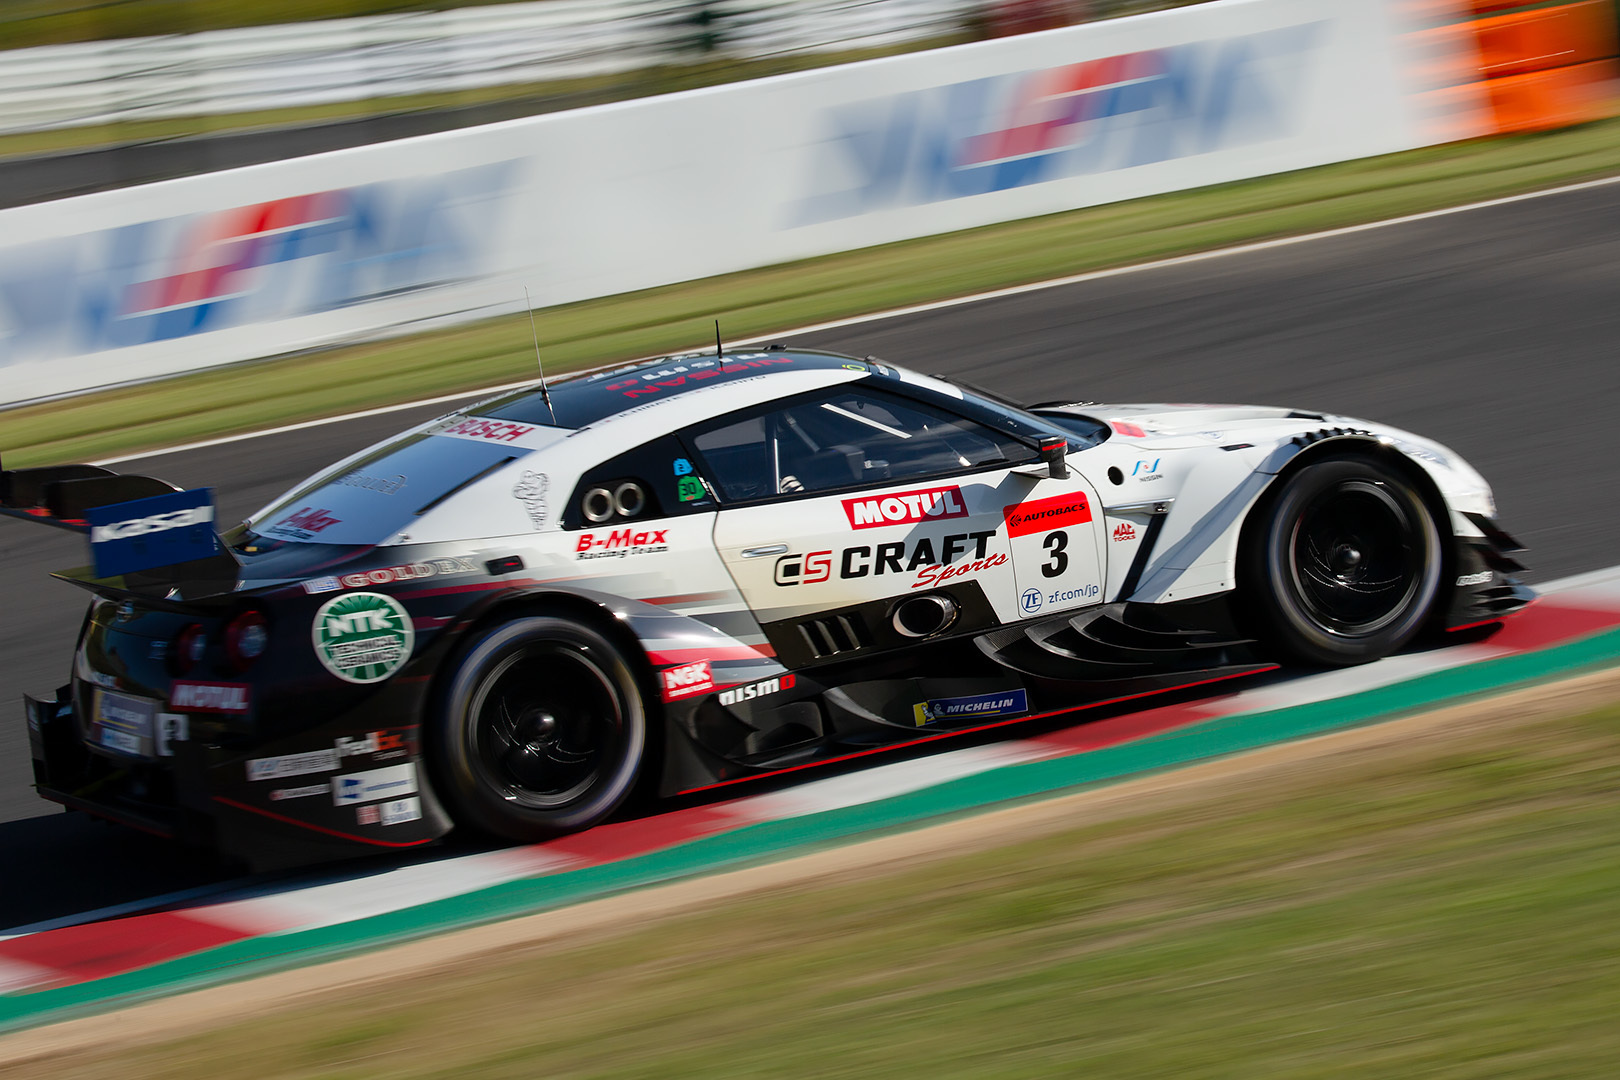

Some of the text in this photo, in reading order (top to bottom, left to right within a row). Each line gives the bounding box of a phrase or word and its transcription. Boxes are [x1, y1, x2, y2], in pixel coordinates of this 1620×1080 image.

[622, 357, 794, 399] NISSAN
[444, 419, 536, 442] BOSCH
[852, 491, 962, 525] MOTUL
[1023, 502, 1086, 523] AUTOBACS
[575, 528, 670, 552] B-Max
[1113, 523, 1135, 537] MAC
[1113, 534, 1136, 542] TOOLS
[576, 546, 668, 560] Racing Team
[840, 529, 997, 580] CRAFT
[1041, 530, 1068, 578] 3
[911, 552, 1010, 589] Sports
[1048, 584, 1099, 604] zf.com/jp
[326, 607, 395, 637] NTK
[664, 662, 711, 689] NGK
[946, 698, 1013, 713] MICHELIN
